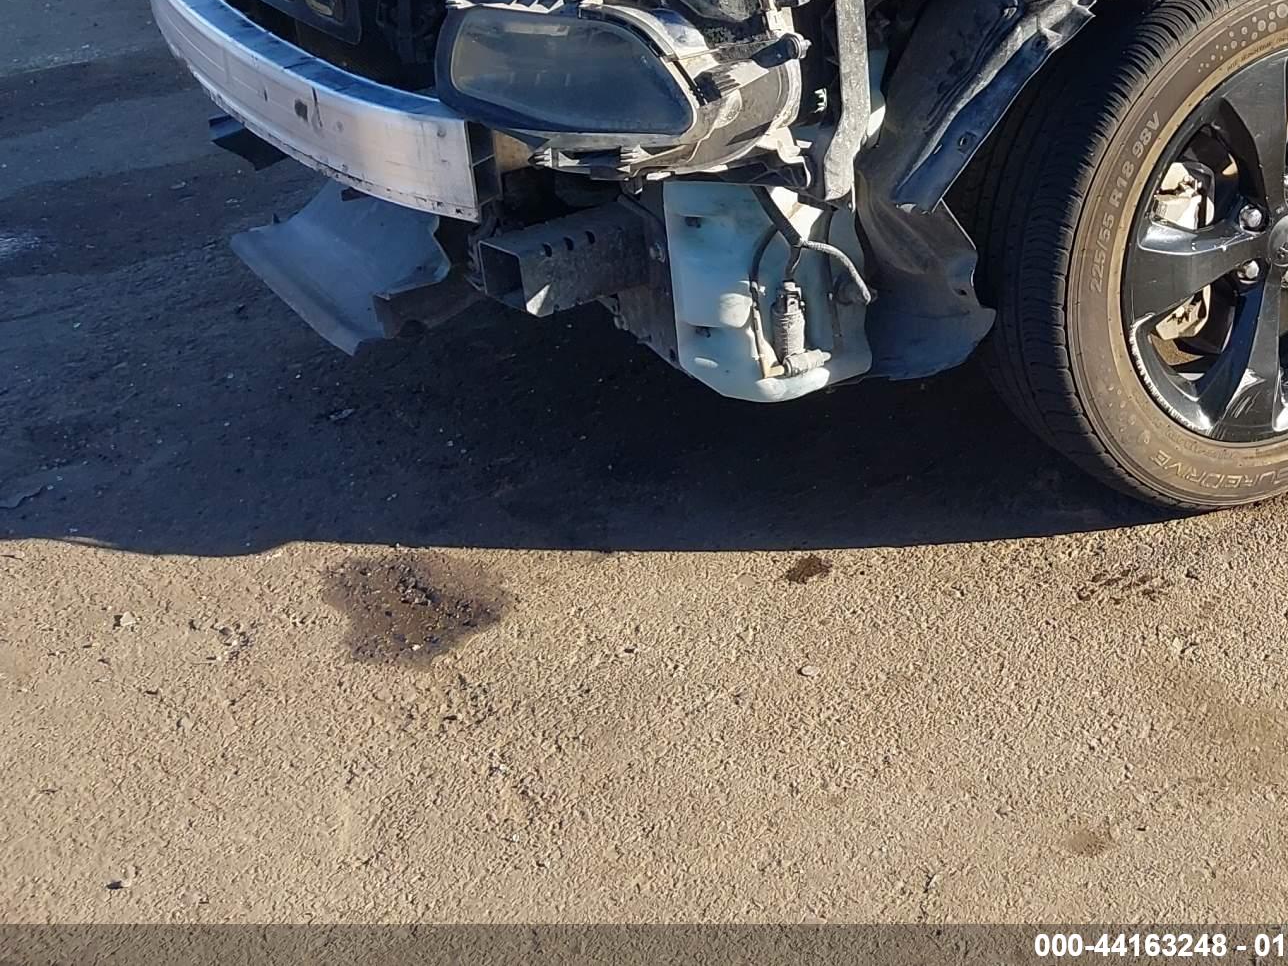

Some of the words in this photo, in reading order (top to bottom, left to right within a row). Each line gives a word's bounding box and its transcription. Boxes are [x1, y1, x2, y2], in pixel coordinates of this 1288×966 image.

[1089, 211, 1115, 293] 225/55
[1109, 160, 1134, 208] R18
[1132, 110, 1161, 158] 98V
